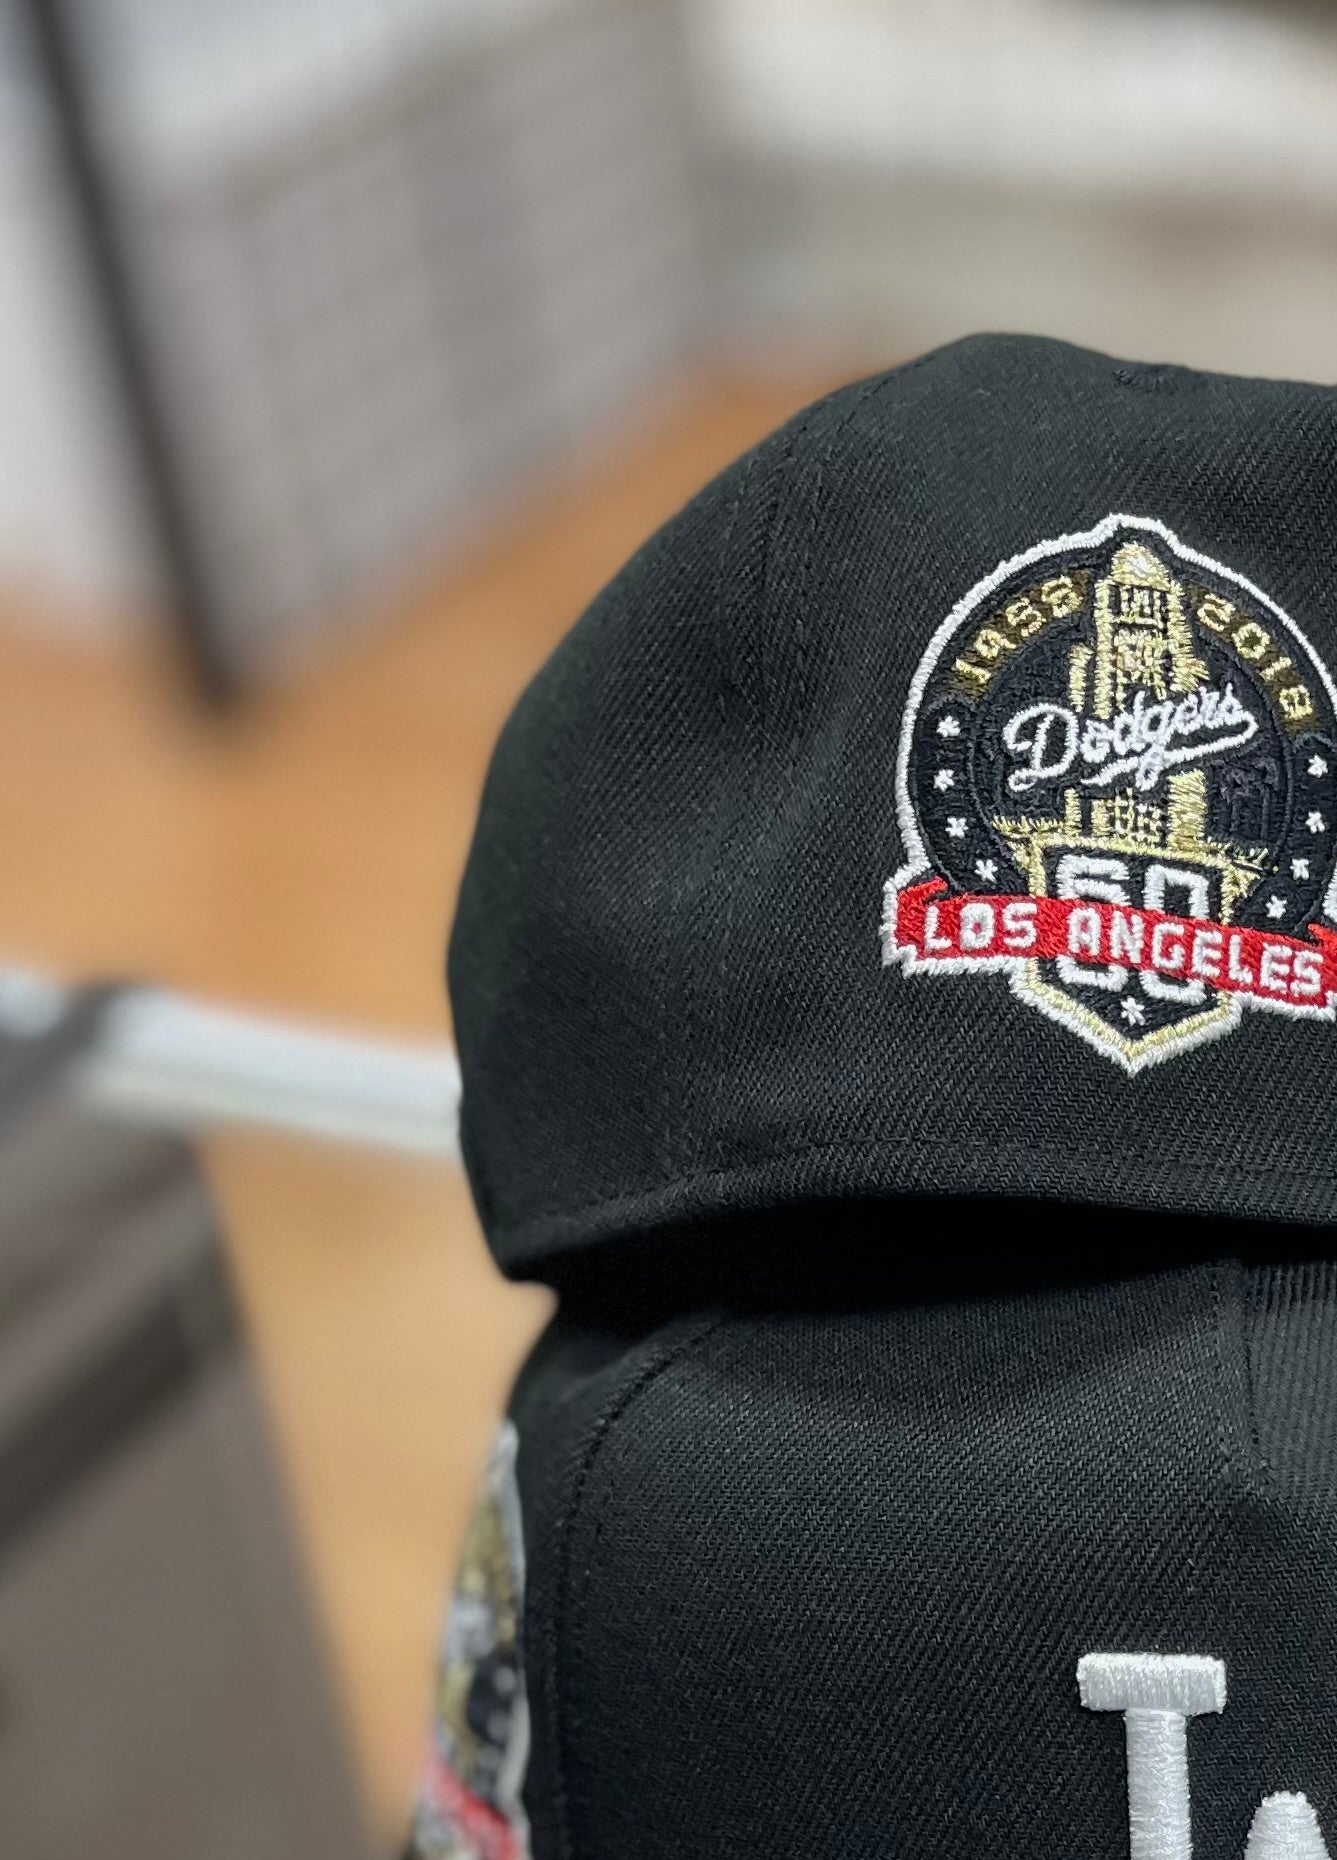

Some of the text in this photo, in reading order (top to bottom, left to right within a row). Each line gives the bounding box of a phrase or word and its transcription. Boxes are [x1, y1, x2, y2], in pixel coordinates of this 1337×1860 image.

[1002, 682, 1260, 792] Dodgers
[923, 901, 1326, 997] LOS ANGELES
